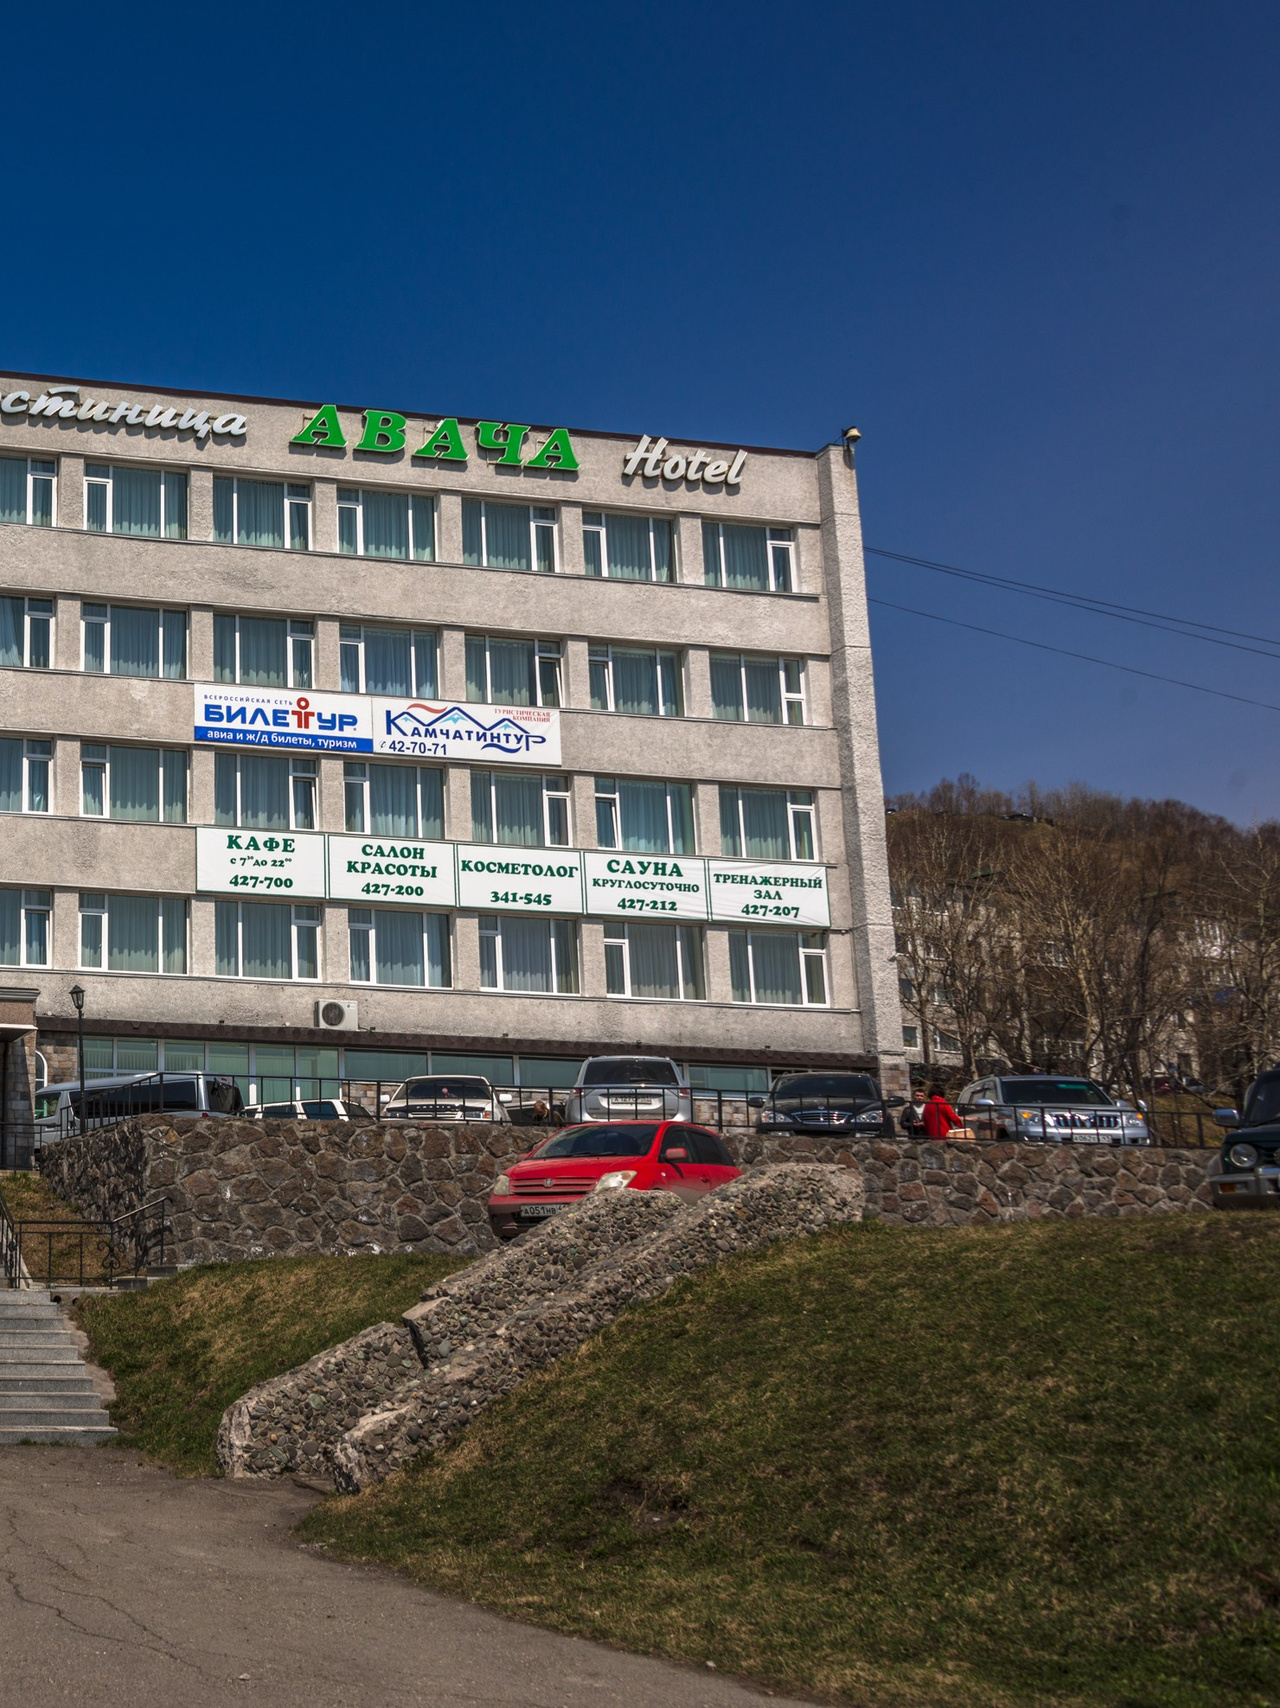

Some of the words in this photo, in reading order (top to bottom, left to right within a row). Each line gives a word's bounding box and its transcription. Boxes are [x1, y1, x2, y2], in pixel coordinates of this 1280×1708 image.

[289, 404, 581, 472] АВАЧА
[623, 434, 749, 485] Hotel
[204, 694, 271, 704] ВСЕРОССИЙСКАЯ
[494, 708, 551, 717] ТУРИСТИЧЕСКАЯ
[512, 715, 551, 723] КОМПАНИЯ
[207, 730, 233, 740] авиа
[236, 732, 243, 741] и
[246, 731, 269, 744] ж/д
[271, 732, 315, 747] билеты,
[318, 739, 357, 749] туризм
[389, 740, 447, 756] 42-70-71
[226, 834, 295, 853] КАФЕ
[361, 844, 425, 860] САЛОН
[346, 861, 437, 879] КРАСОТЫ
[461, 859, 578, 878] КОСМЕТОЛОГ
[606, 859, 683, 878] САУНА
[229, 874, 293, 889] 427-700
[592, 878, 700, 893] КРУГЛОСУТОЧНО
[713, 872, 823, 889] ТРЕНАЖЕРНЫЙ
[361, 882, 424, 897] 427-200
[753, 889, 782, 901] ЗАЛ
[490, 891, 552, 906] 341-545
[617, 898, 678, 912] 427-212
[741, 903, 800, 918] 427-207
